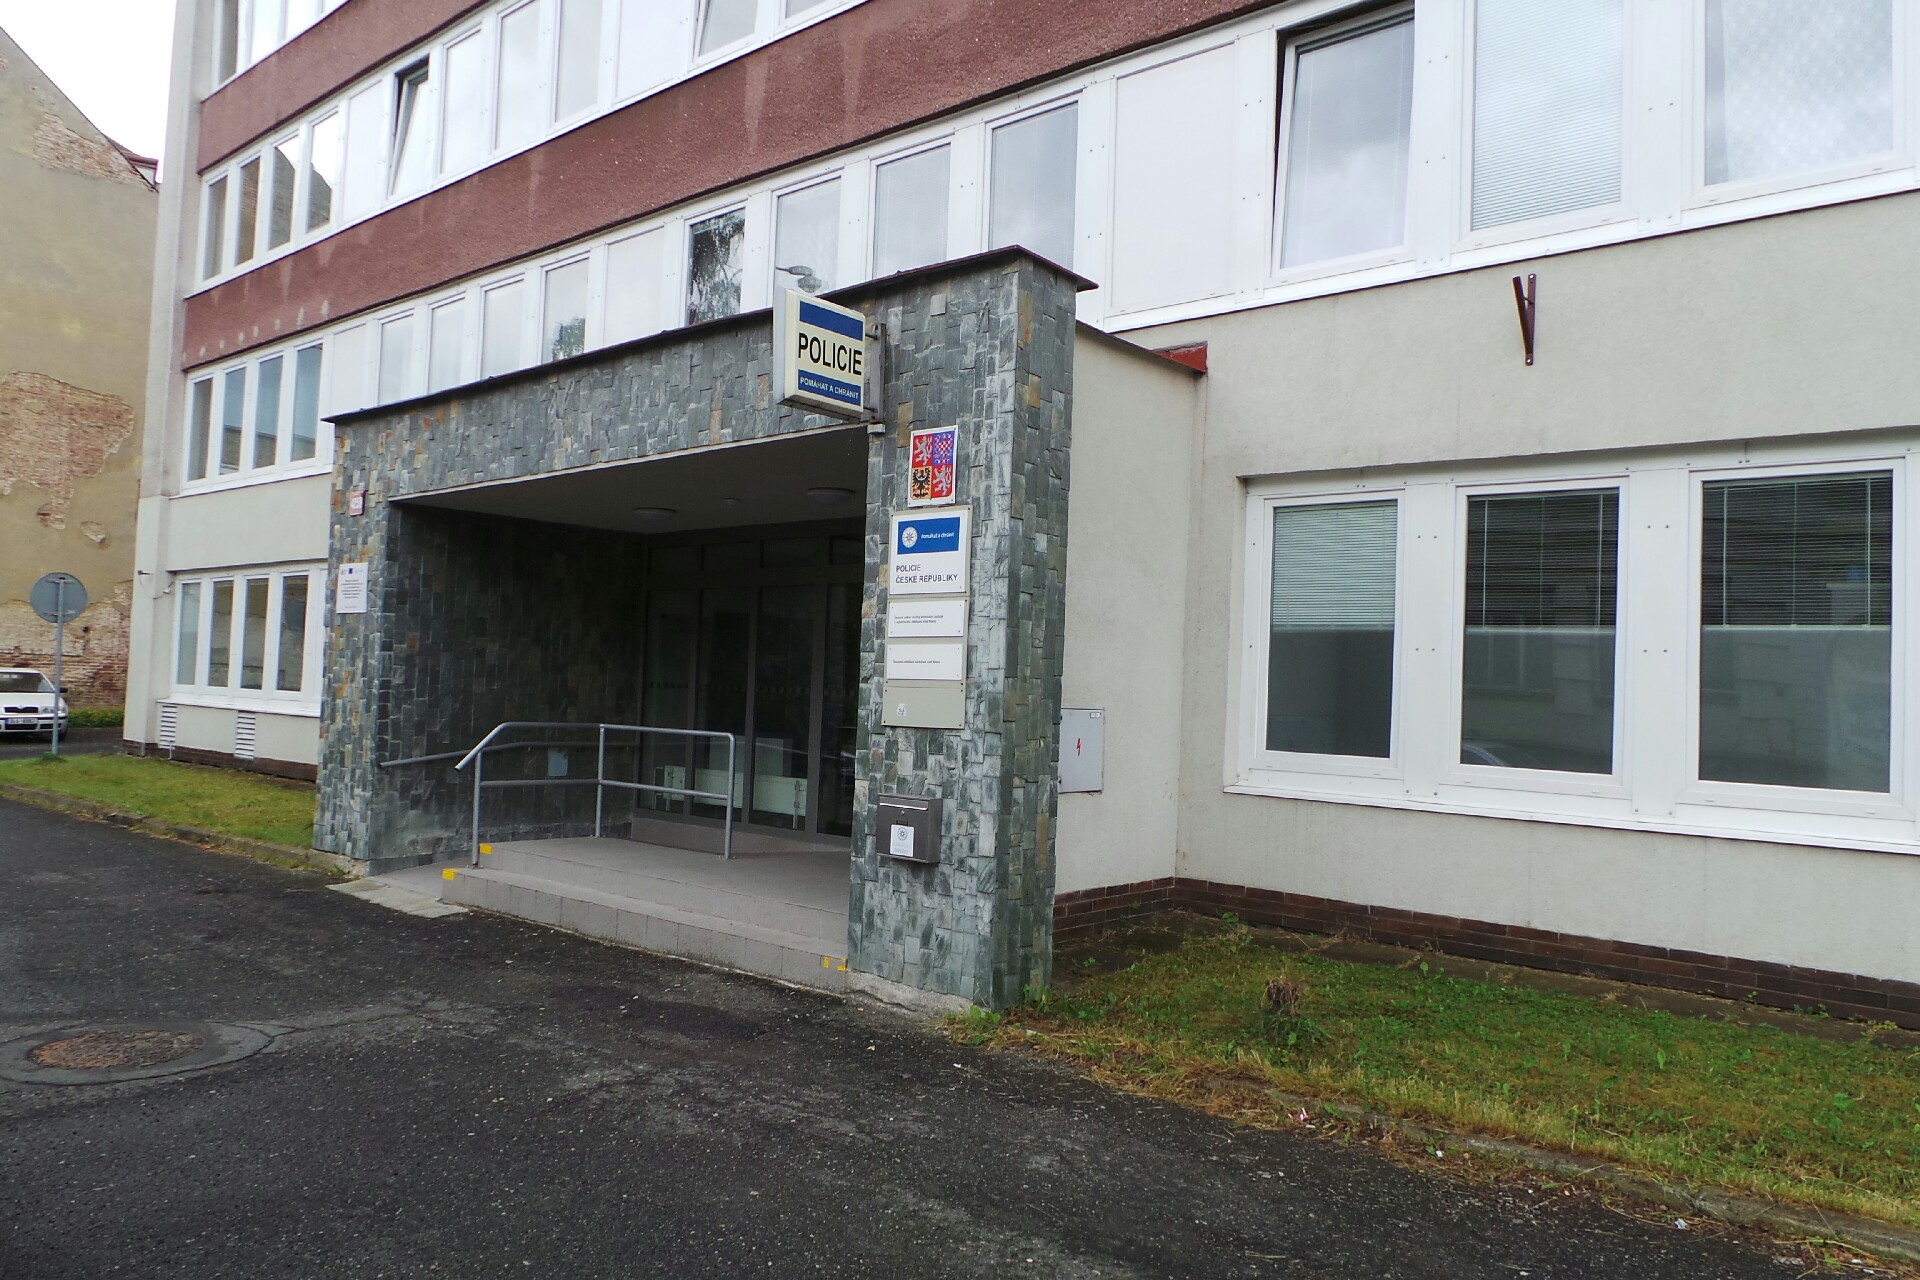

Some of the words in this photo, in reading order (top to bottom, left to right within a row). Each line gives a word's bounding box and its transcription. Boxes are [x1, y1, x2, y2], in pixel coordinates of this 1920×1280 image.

[798, 332, 863, 376] POLICIE
[829, 385, 834, 393] A
[895, 564, 921, 573] POLICIE
[895, 574, 917, 584] ČESKÉ
[919, 574, 959, 583] REPUBLIKY
